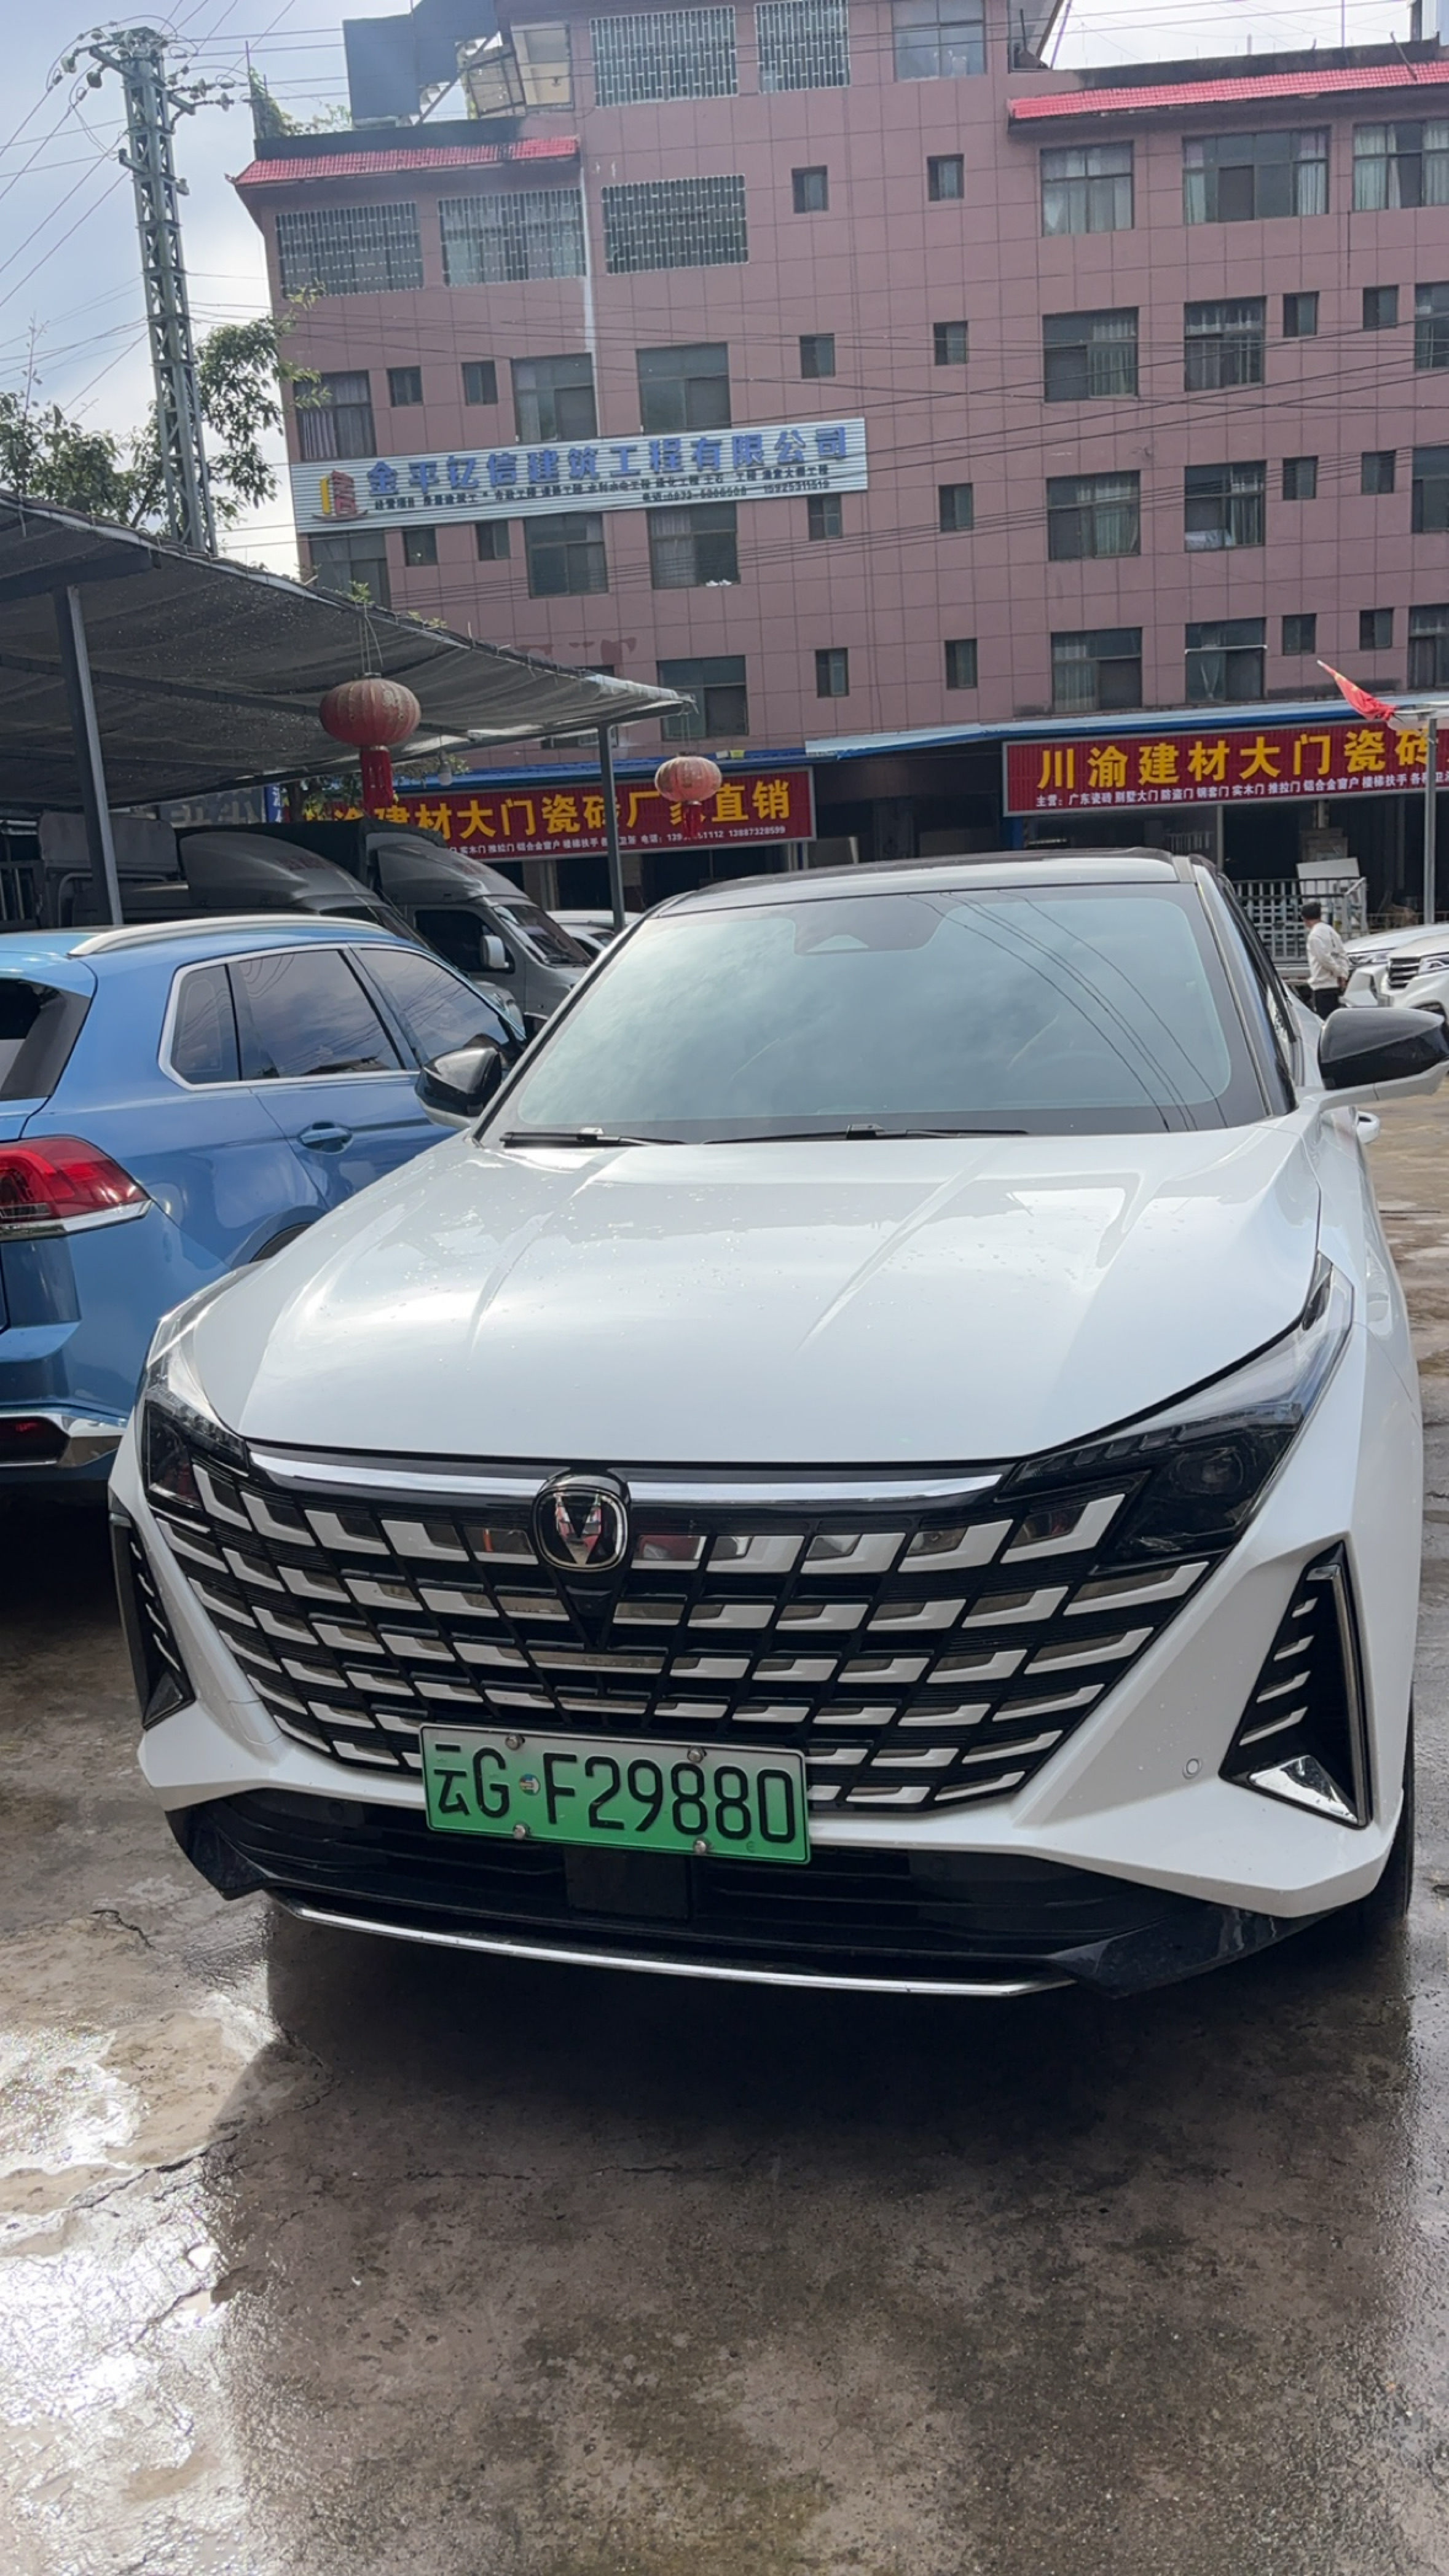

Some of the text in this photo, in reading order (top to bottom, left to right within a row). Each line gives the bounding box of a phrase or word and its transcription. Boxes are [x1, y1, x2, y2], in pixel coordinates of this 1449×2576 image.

[1037, 728, 1449, 790] 川渝建材大门瓷砖
